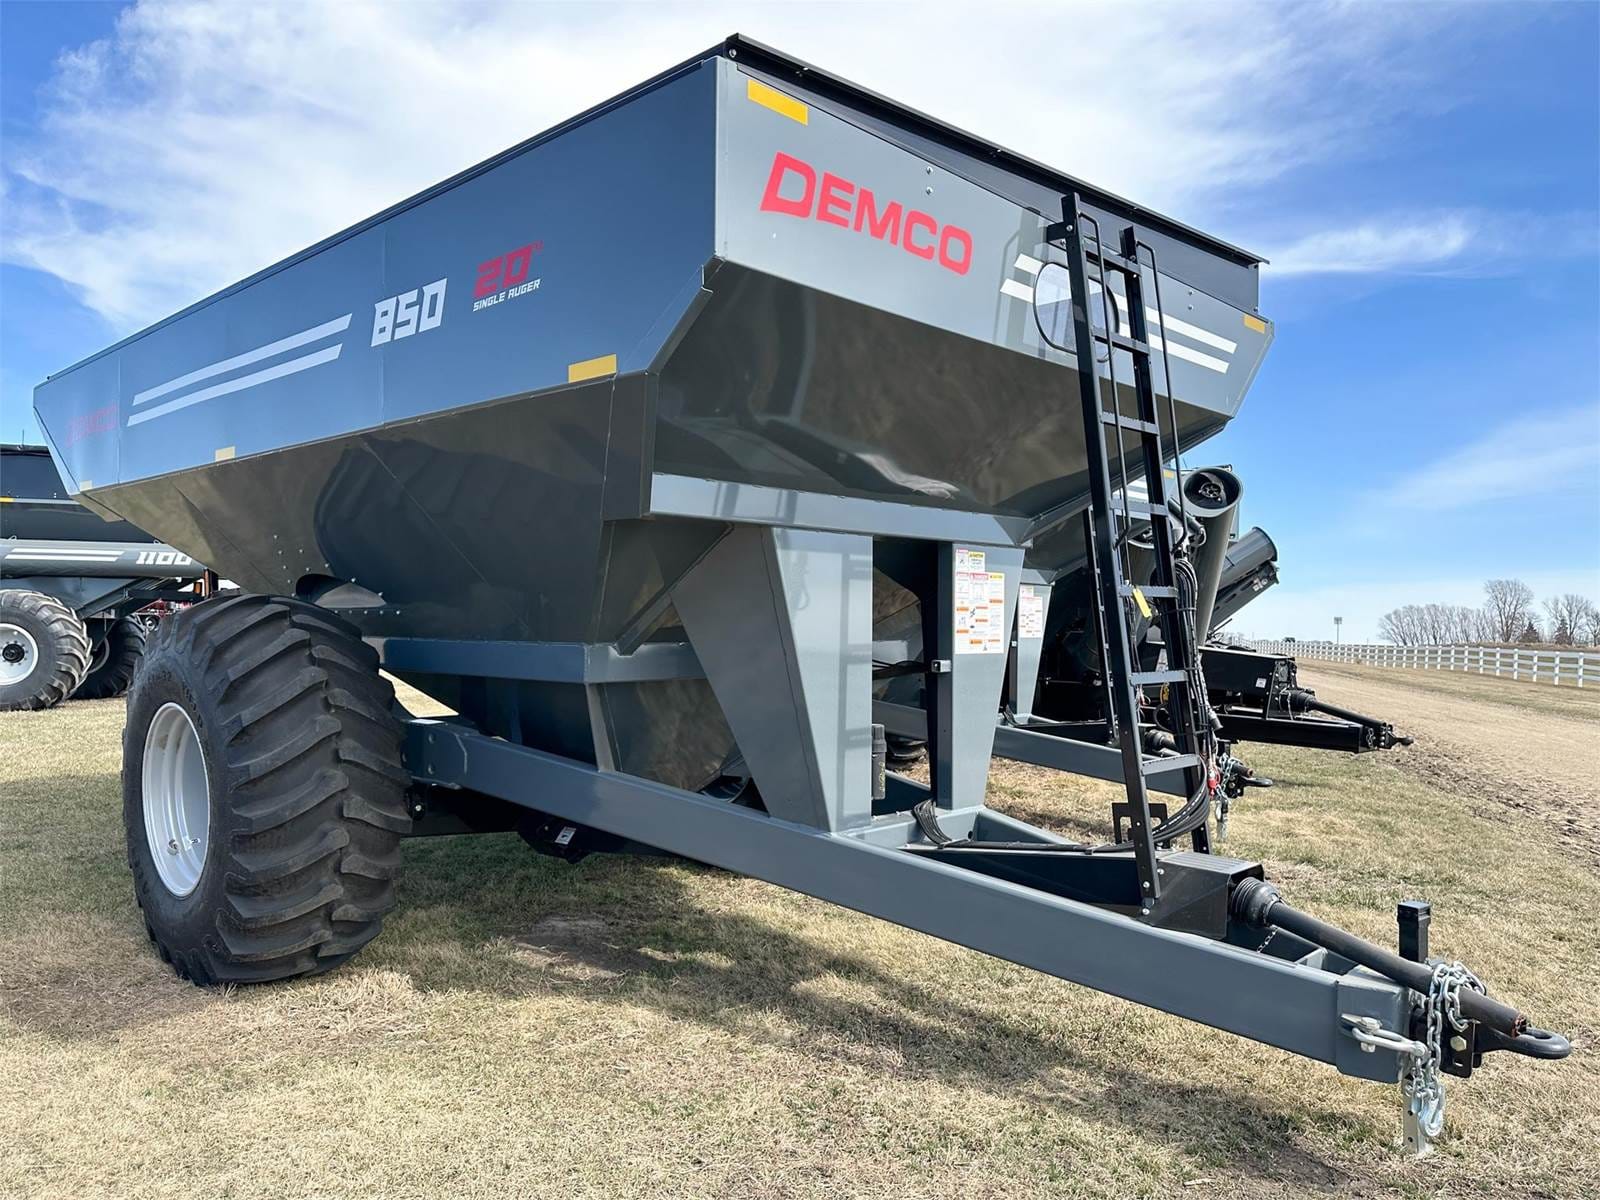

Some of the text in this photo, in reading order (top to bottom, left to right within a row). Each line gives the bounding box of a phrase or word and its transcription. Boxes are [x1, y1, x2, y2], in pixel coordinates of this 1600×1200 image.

[760, 151, 973, 276] DEMCO
[371, 278, 448, 347] 850
[473, 279, 542, 313] SINGLE AUGER
[136, 551, 193, 566] 1100
